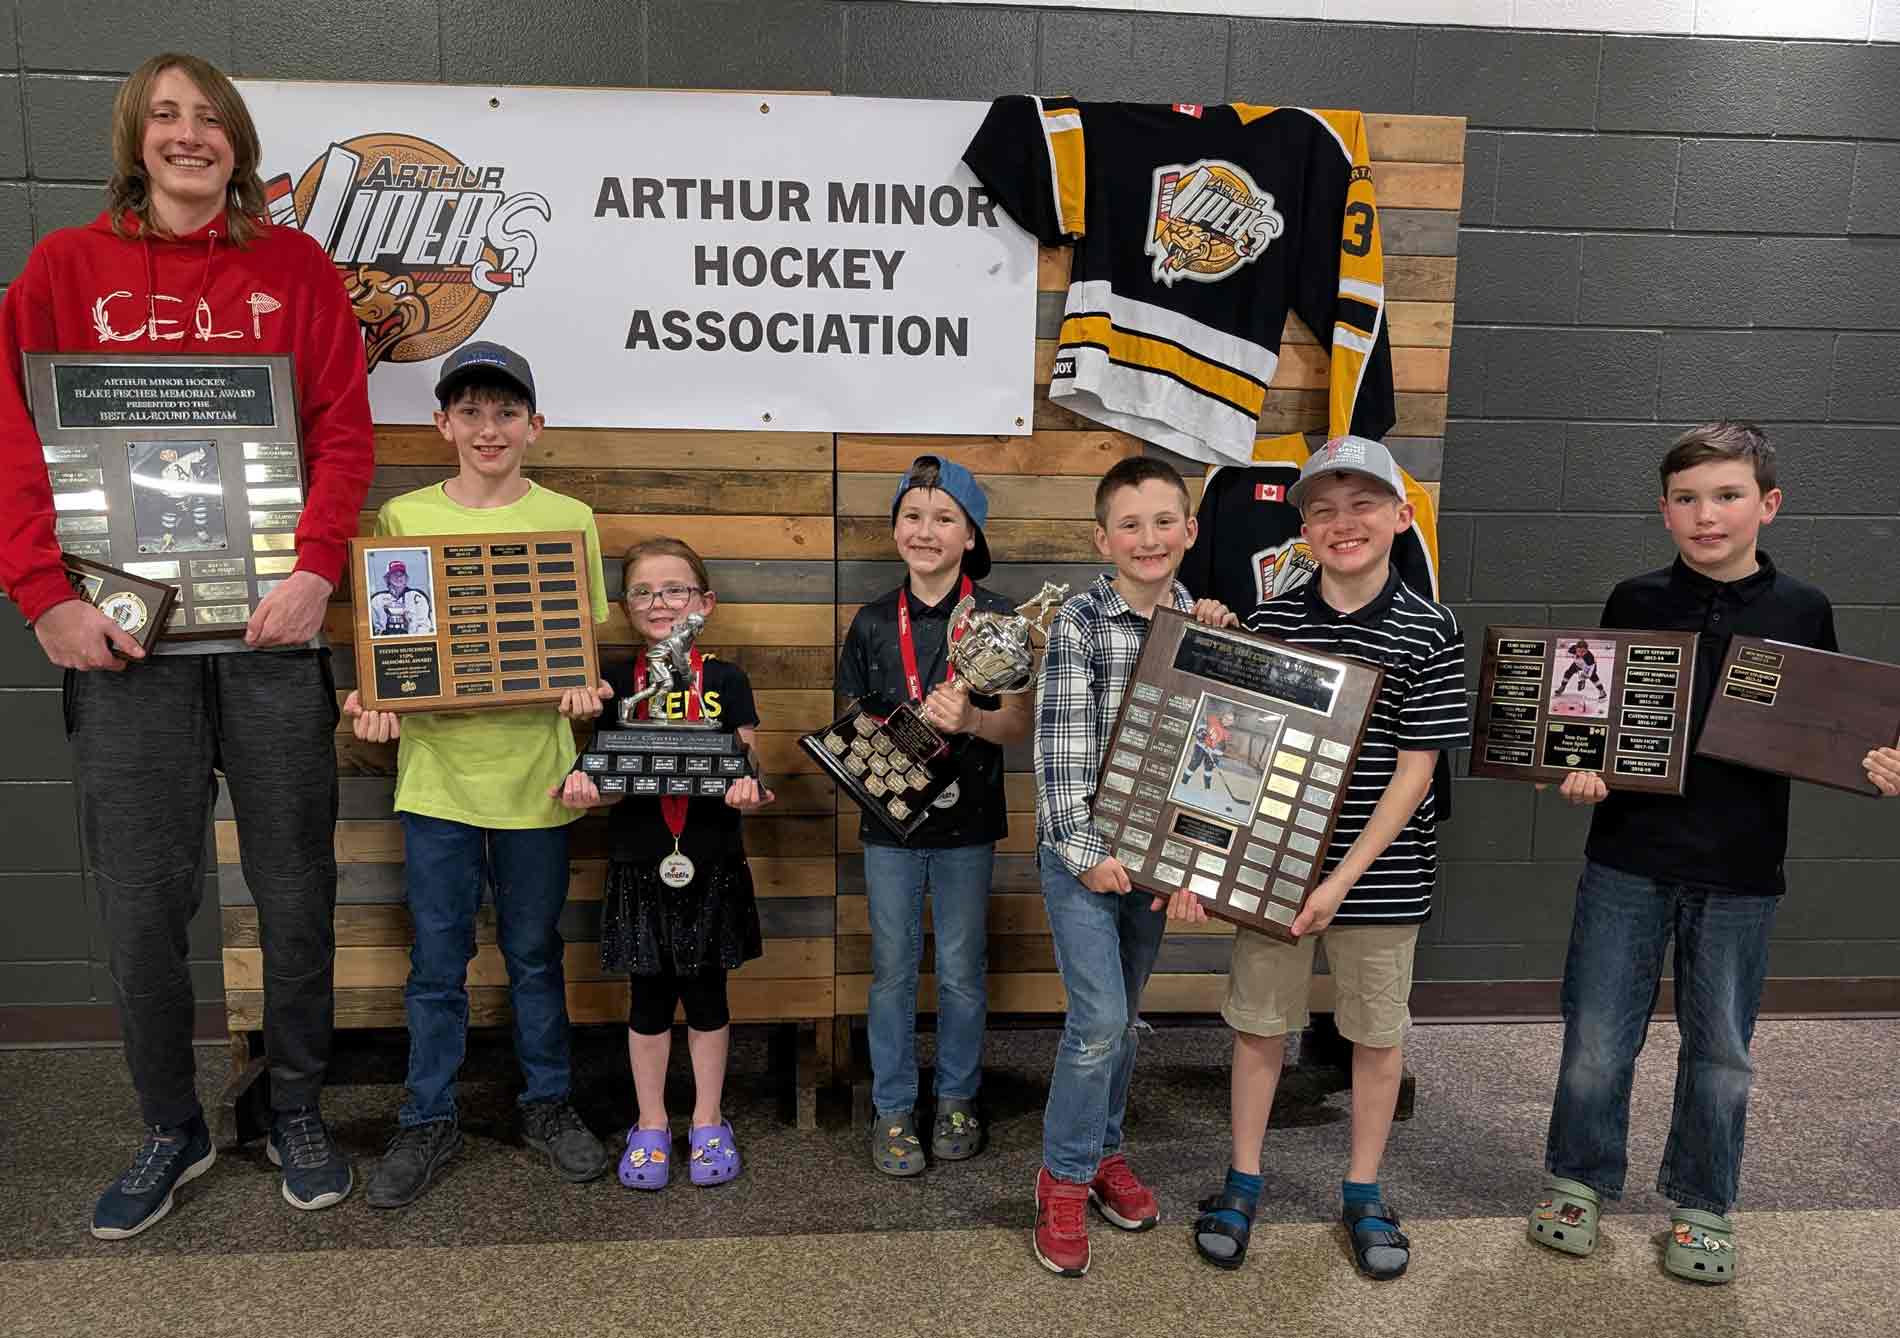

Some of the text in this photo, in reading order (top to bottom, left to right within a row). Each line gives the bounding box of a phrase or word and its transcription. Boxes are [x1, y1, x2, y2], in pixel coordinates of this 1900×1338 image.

[365, 156, 505, 190] ARTHUR
[593, 176, 1001, 228] ARTHUR MINOR
[1212, 178, 1268, 210] ARTHUR
[1343, 201, 1375, 257] 3
[693, 245, 906, 290] HOCKEY
[624, 309, 969, 357] ASSOCIATION
[74, 389, 256, 399] BLAKE FISCHER MEMORIAL AWARD
[104, 378, 226, 386] ARTHUR MINOR HOCKEY
[100, 411, 127, 421] BEST
[192, 411, 237, 421] BANTAM
